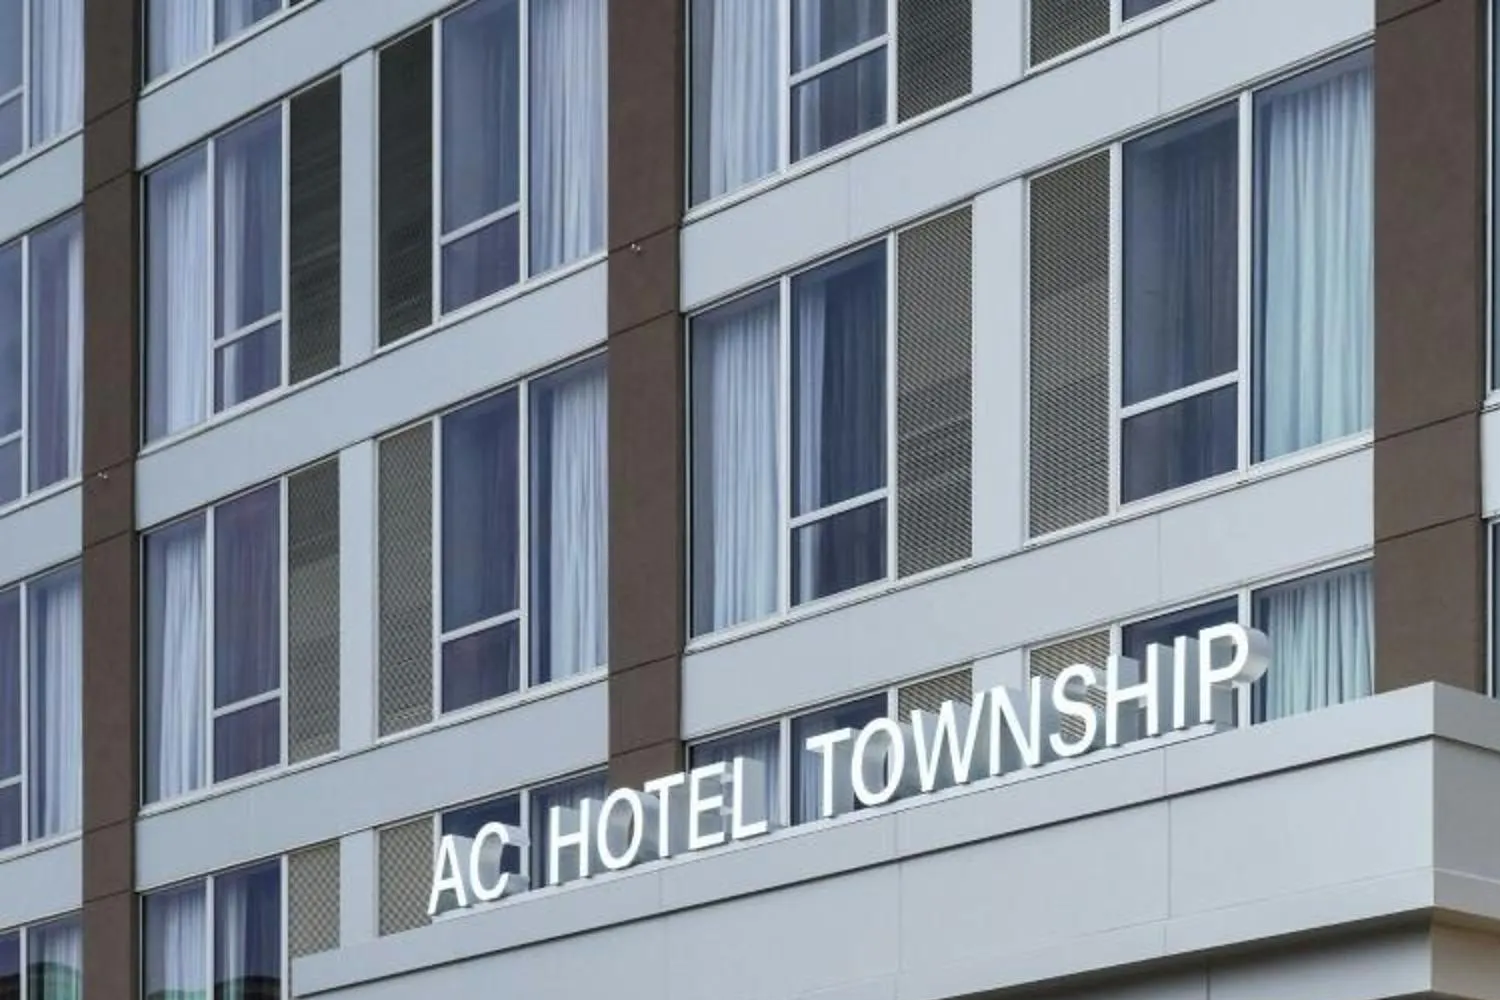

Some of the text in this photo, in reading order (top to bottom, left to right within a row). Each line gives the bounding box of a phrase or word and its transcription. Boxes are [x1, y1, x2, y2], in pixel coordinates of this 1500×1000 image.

[427, 621, 1252, 915] AC HOTEL TOWNSHIP
